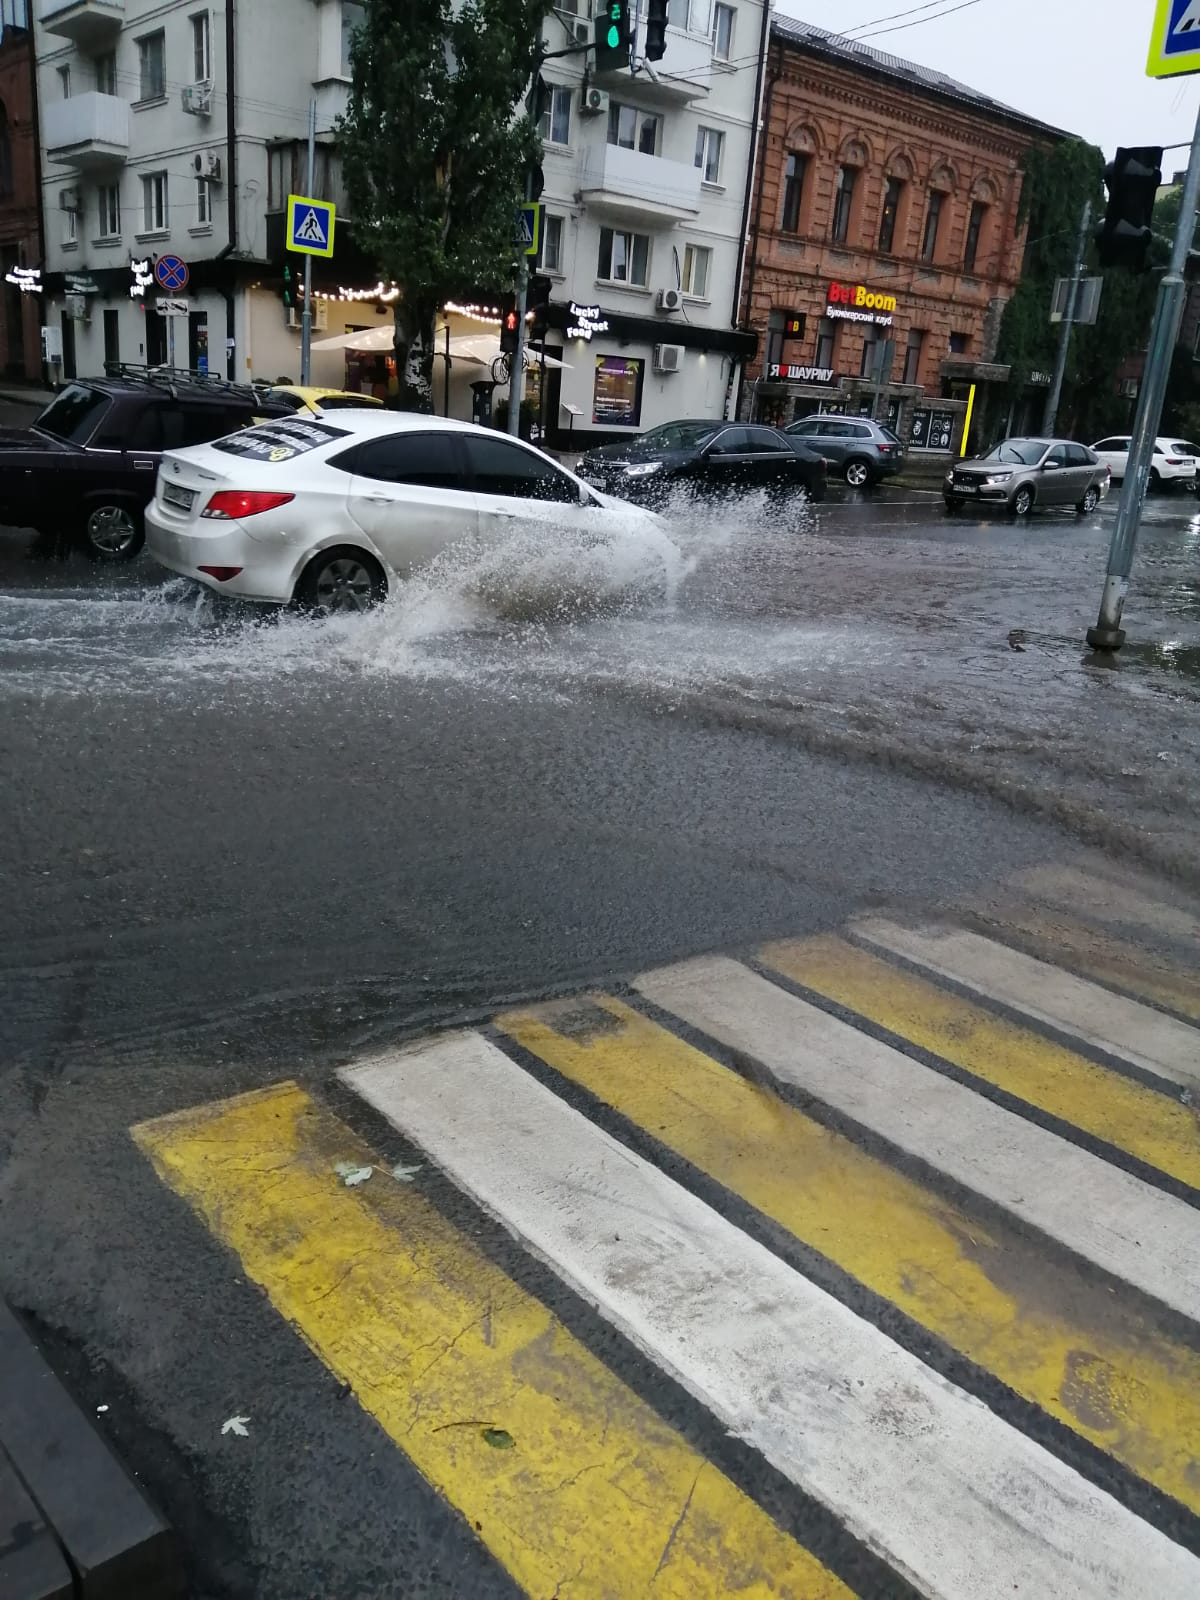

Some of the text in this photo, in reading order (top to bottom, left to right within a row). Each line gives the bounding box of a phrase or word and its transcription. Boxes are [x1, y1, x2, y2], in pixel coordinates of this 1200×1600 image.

[828, 281, 897, 312] BetBoom
[570, 303, 599, 319] Lucky
[826, 305, 893, 327] Букмекерский клуб
[578, 317, 609, 331] Street
[566, 327, 592, 340] Food
[786, 365, 834, 382] ШАУРМУ
